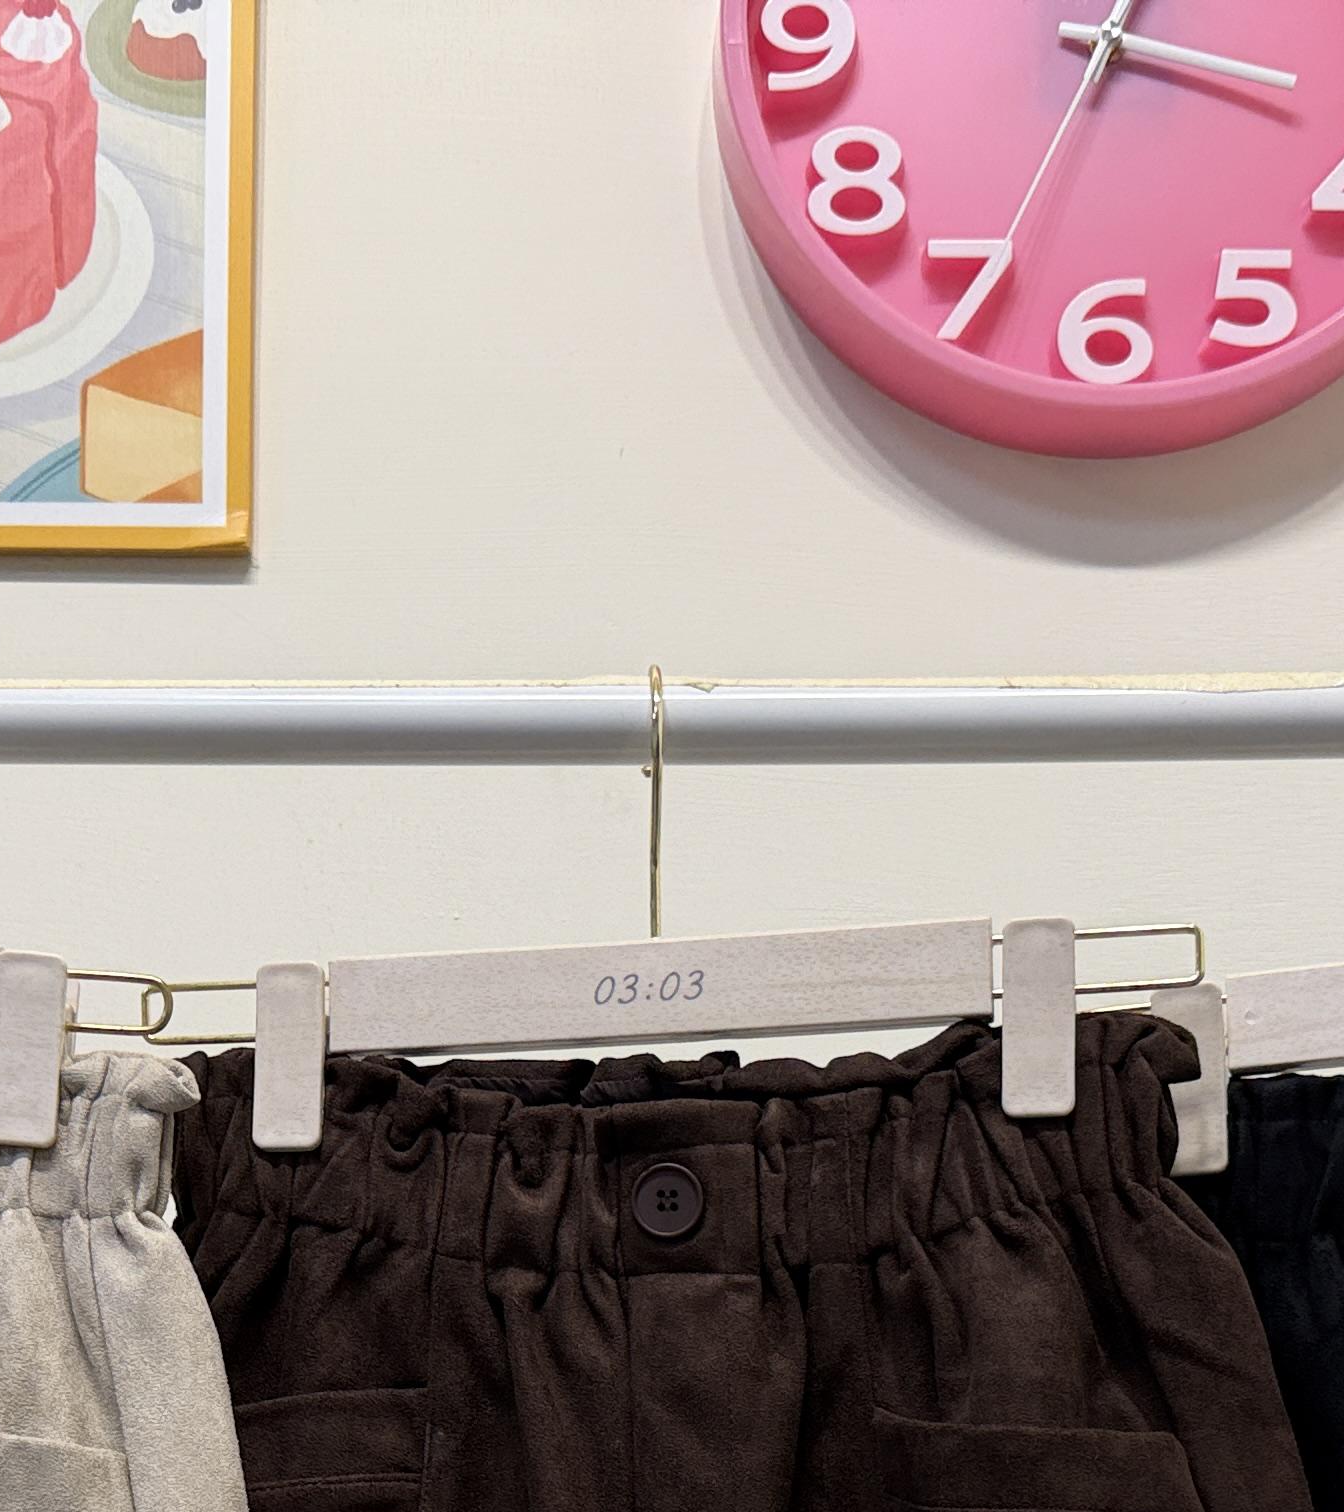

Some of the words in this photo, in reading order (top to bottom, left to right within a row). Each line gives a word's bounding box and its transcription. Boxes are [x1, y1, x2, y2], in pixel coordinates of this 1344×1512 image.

[760, 0, 856, 91] 9
[807, 126, 907, 236] 8
[927, 239, 1013, 340] 7
[1057, 278, 1154, 385] 6
[1209, 248, 1299, 347] 5
[593, 969, 705, 1006] 03:03
